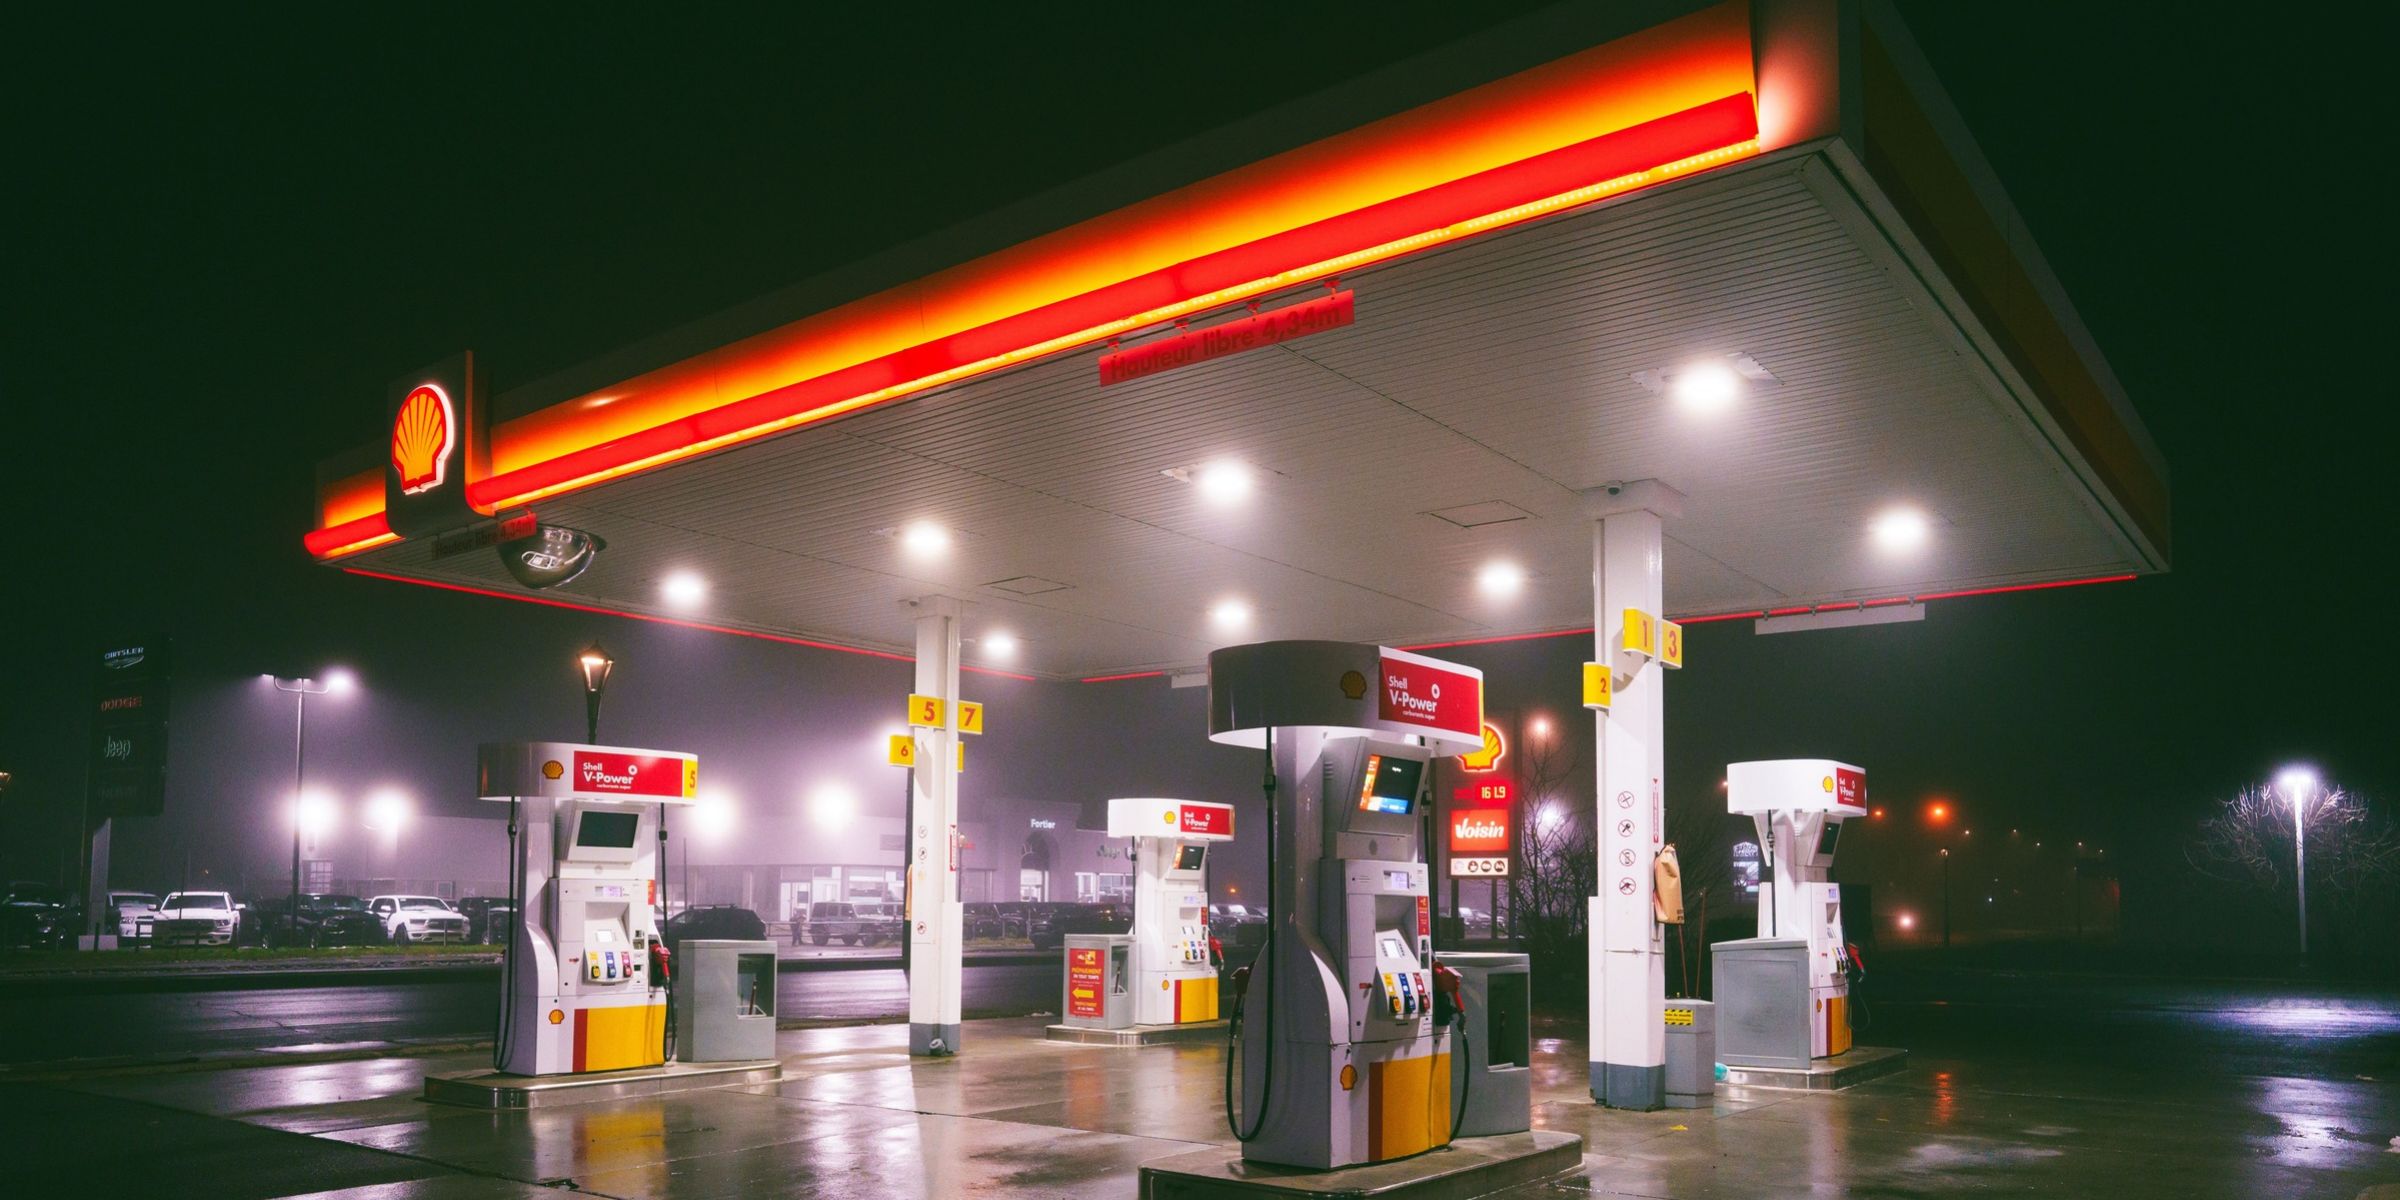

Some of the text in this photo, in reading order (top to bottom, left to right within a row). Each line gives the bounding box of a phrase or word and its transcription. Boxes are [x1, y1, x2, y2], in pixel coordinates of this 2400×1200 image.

[1110, 306, 1341, 380] Hauteur libre 4,34m
[1642, 619, 1648, 648] 1
[1668, 630, 1677, 658] 3
[1388, 675, 1408, 690] Shell
[1600, 677, 1607, 694] 2
[1389, 689, 1437, 713] V-Power
[923, 701, 935, 722] 5
[964, 707, 976, 727] 7
[104, 735, 131, 761] Jeep
[900, 745, 909, 757] 6
[583, 762, 603, 771] Shell
[583, 771, 634, 785] V-Power
[689, 770, 696, 789] 5
[1030, 818, 1056, 829] Fortier
[1455, 817, 1505, 839] Voisin
